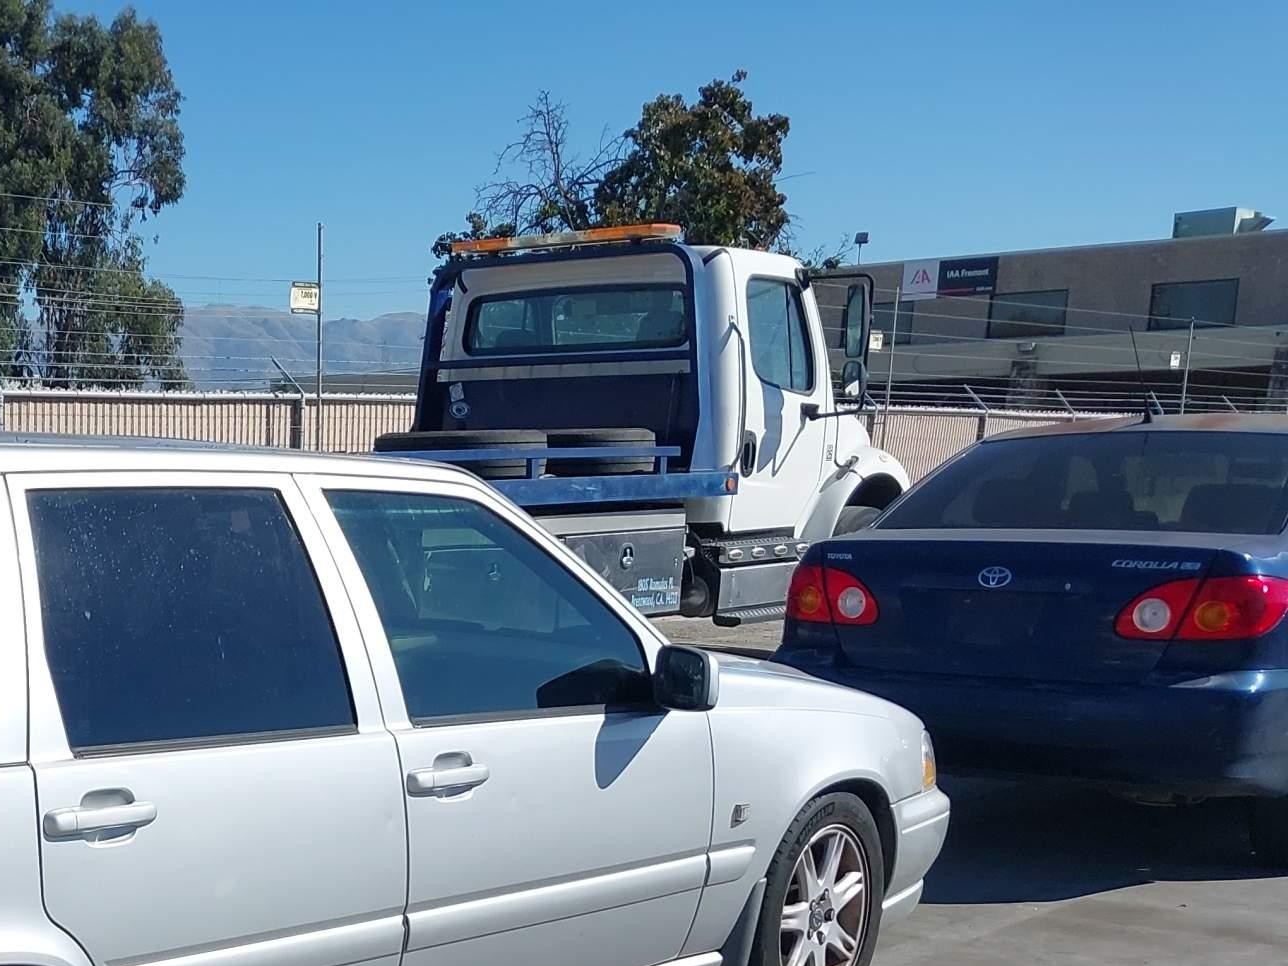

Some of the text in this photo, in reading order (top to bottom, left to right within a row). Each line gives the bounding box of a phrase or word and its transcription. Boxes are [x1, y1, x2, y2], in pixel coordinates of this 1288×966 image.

[946, 268, 989, 279] IAA Fremont
[827, 552, 852, 560] TOYOTA
[1111, 559, 1179, 569] COROLLA
